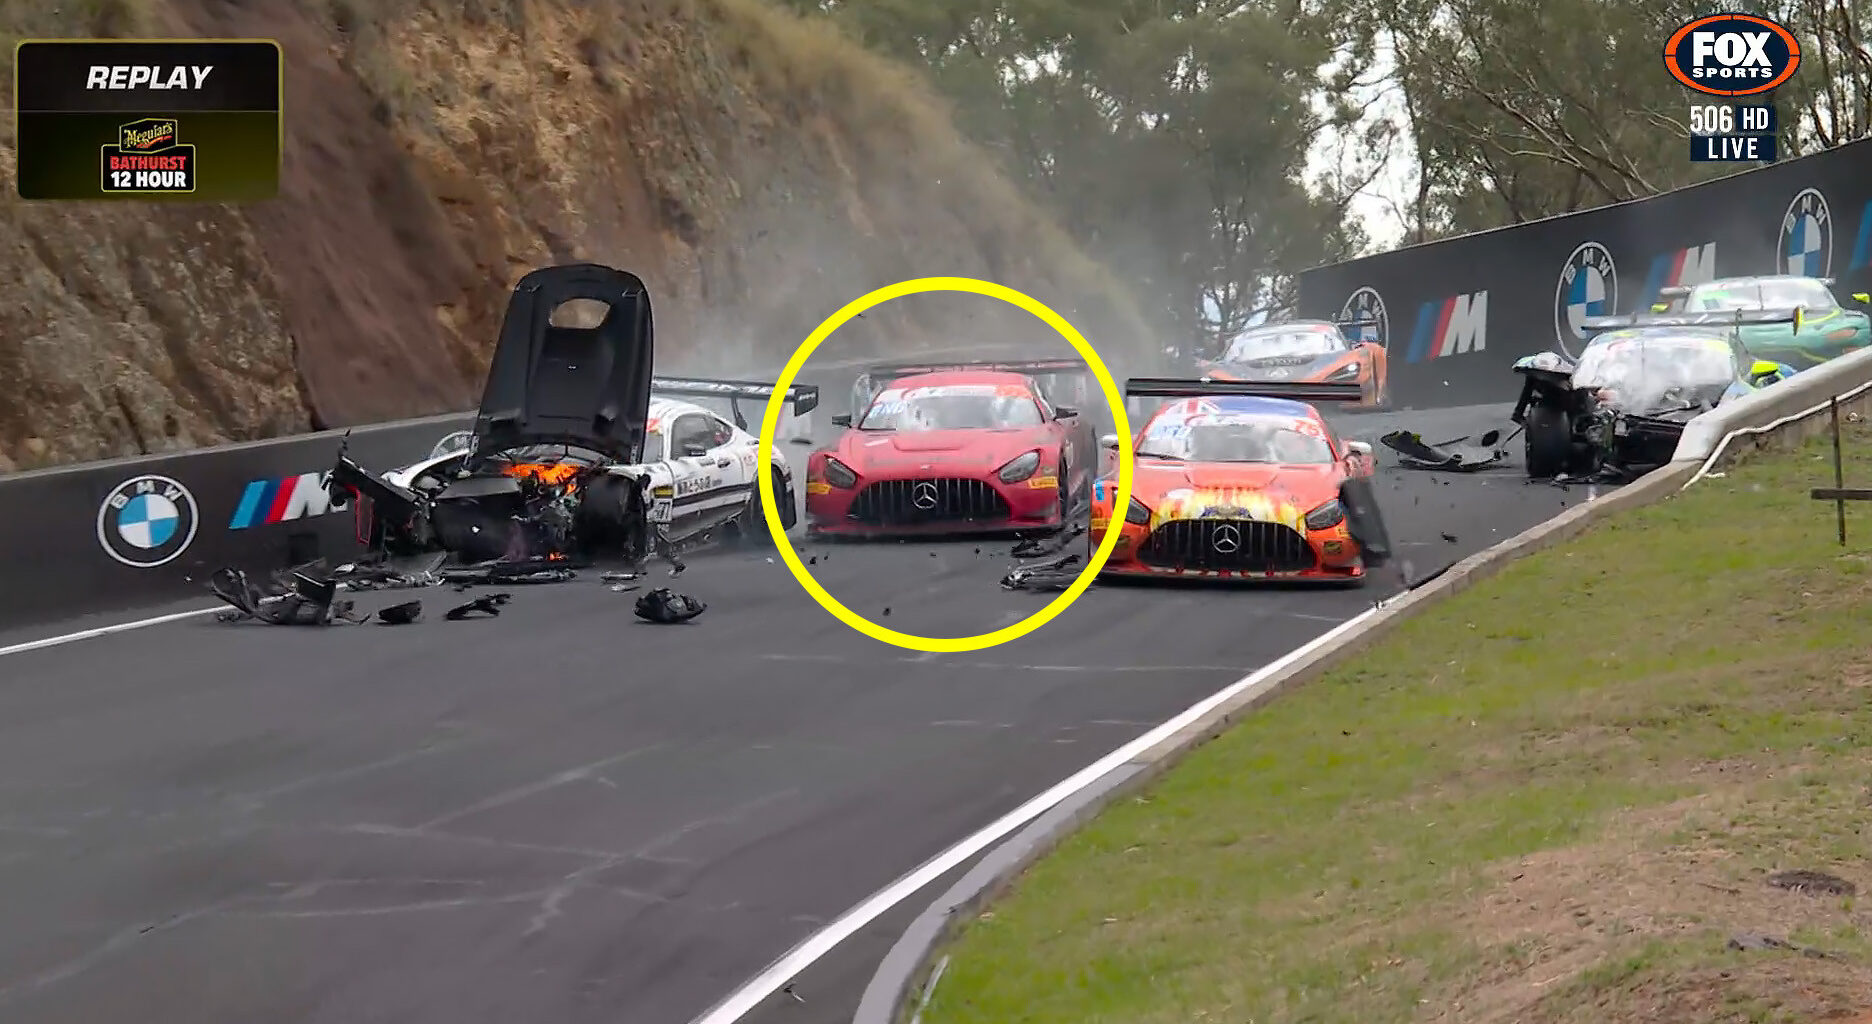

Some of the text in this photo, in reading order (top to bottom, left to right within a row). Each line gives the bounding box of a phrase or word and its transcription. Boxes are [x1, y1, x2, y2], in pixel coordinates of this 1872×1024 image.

[1784, 194, 1827, 235] BMW
[1564, 247, 1611, 286] BMW
[109, 480, 185, 509] BMW
